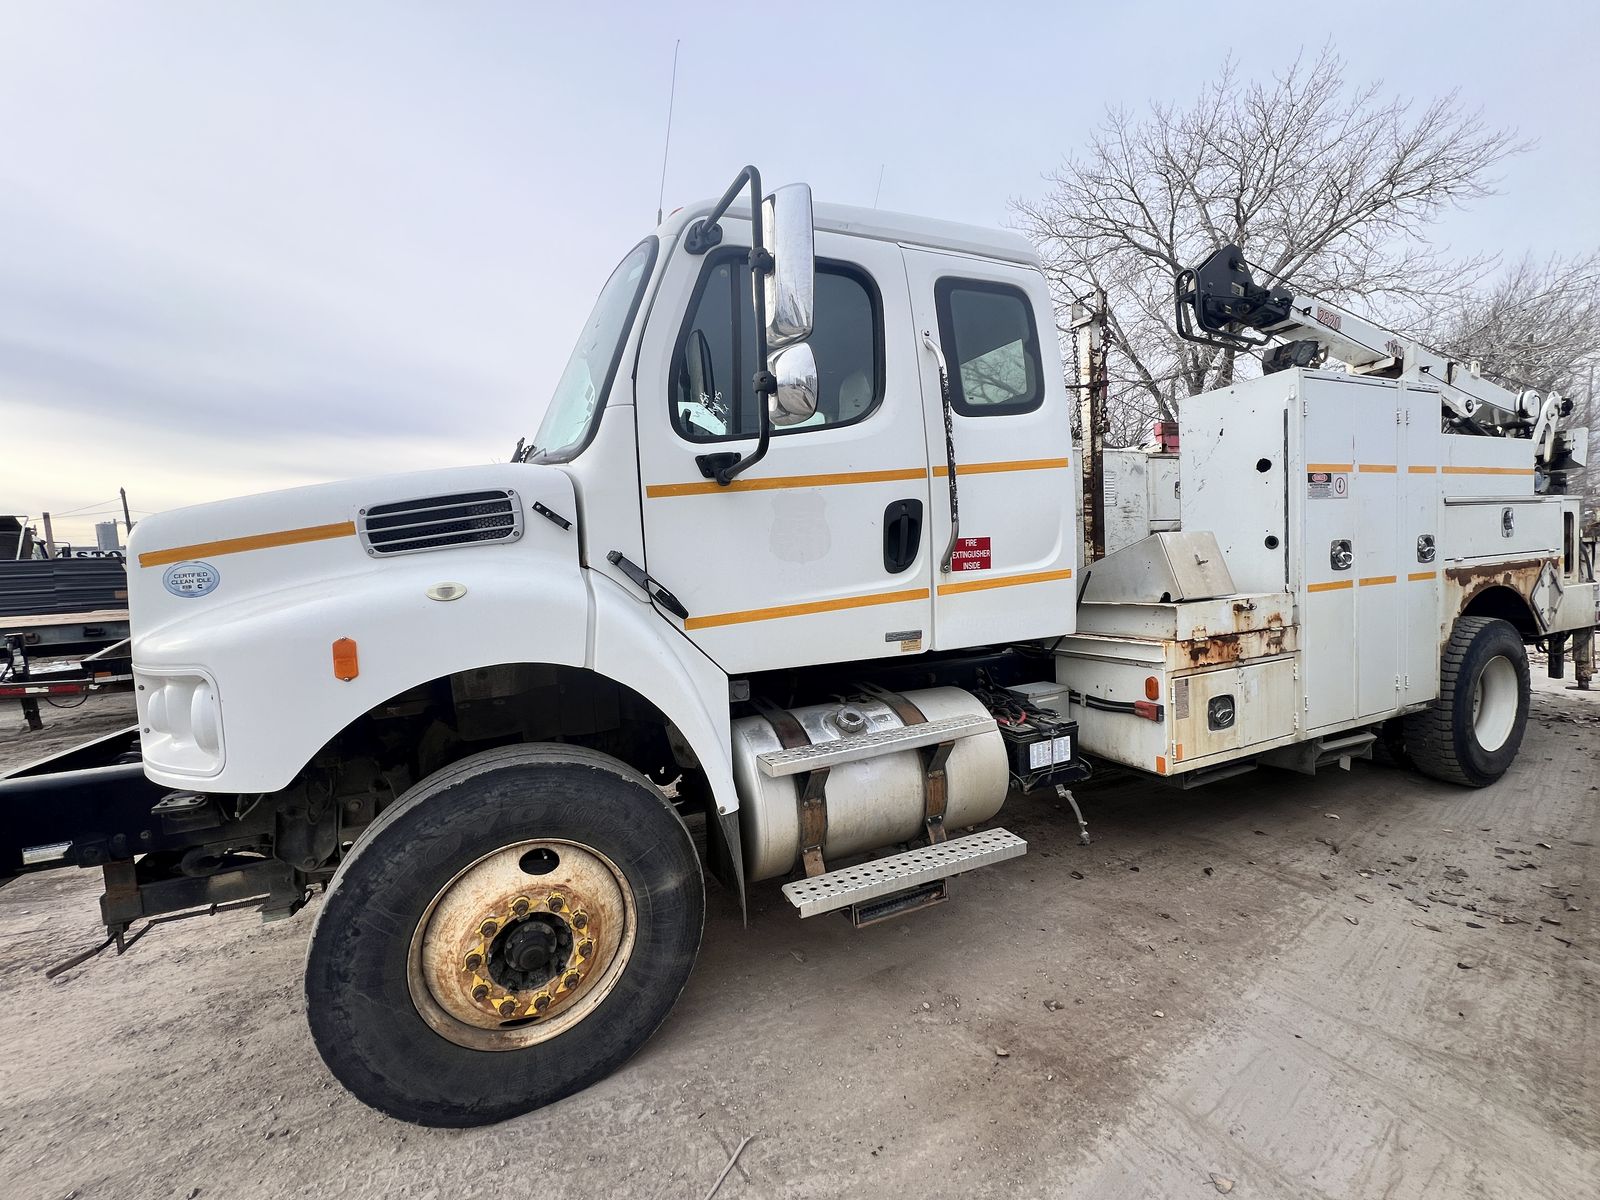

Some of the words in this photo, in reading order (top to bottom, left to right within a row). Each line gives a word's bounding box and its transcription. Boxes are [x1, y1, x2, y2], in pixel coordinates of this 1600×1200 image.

[965, 538, 978, 547] FIRE
[952, 549, 991, 560] EXTINGUISHER
[962, 561, 981, 570] INSIDE
